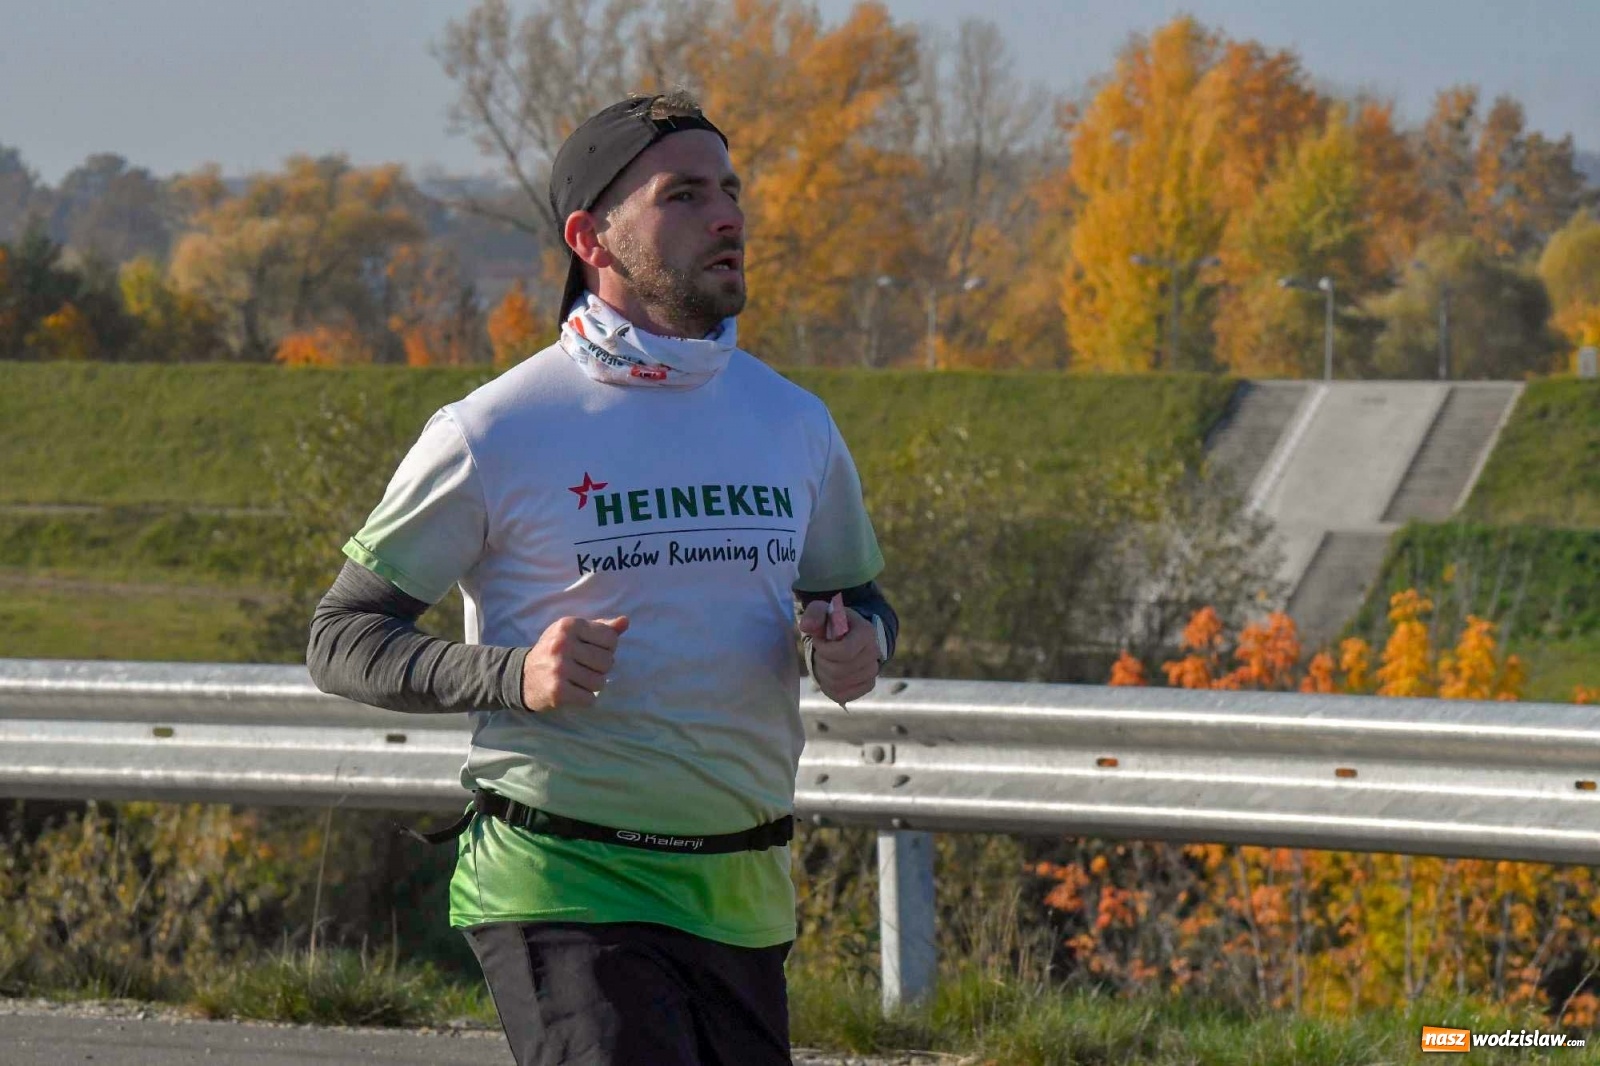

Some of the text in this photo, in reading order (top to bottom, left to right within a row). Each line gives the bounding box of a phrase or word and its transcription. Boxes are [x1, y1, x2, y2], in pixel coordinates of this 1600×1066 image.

[595, 484, 794, 527] HEINEKEN
[577, 537, 796, 576] Kraków Running Club
[644, 834, 704, 850] Kalenji
